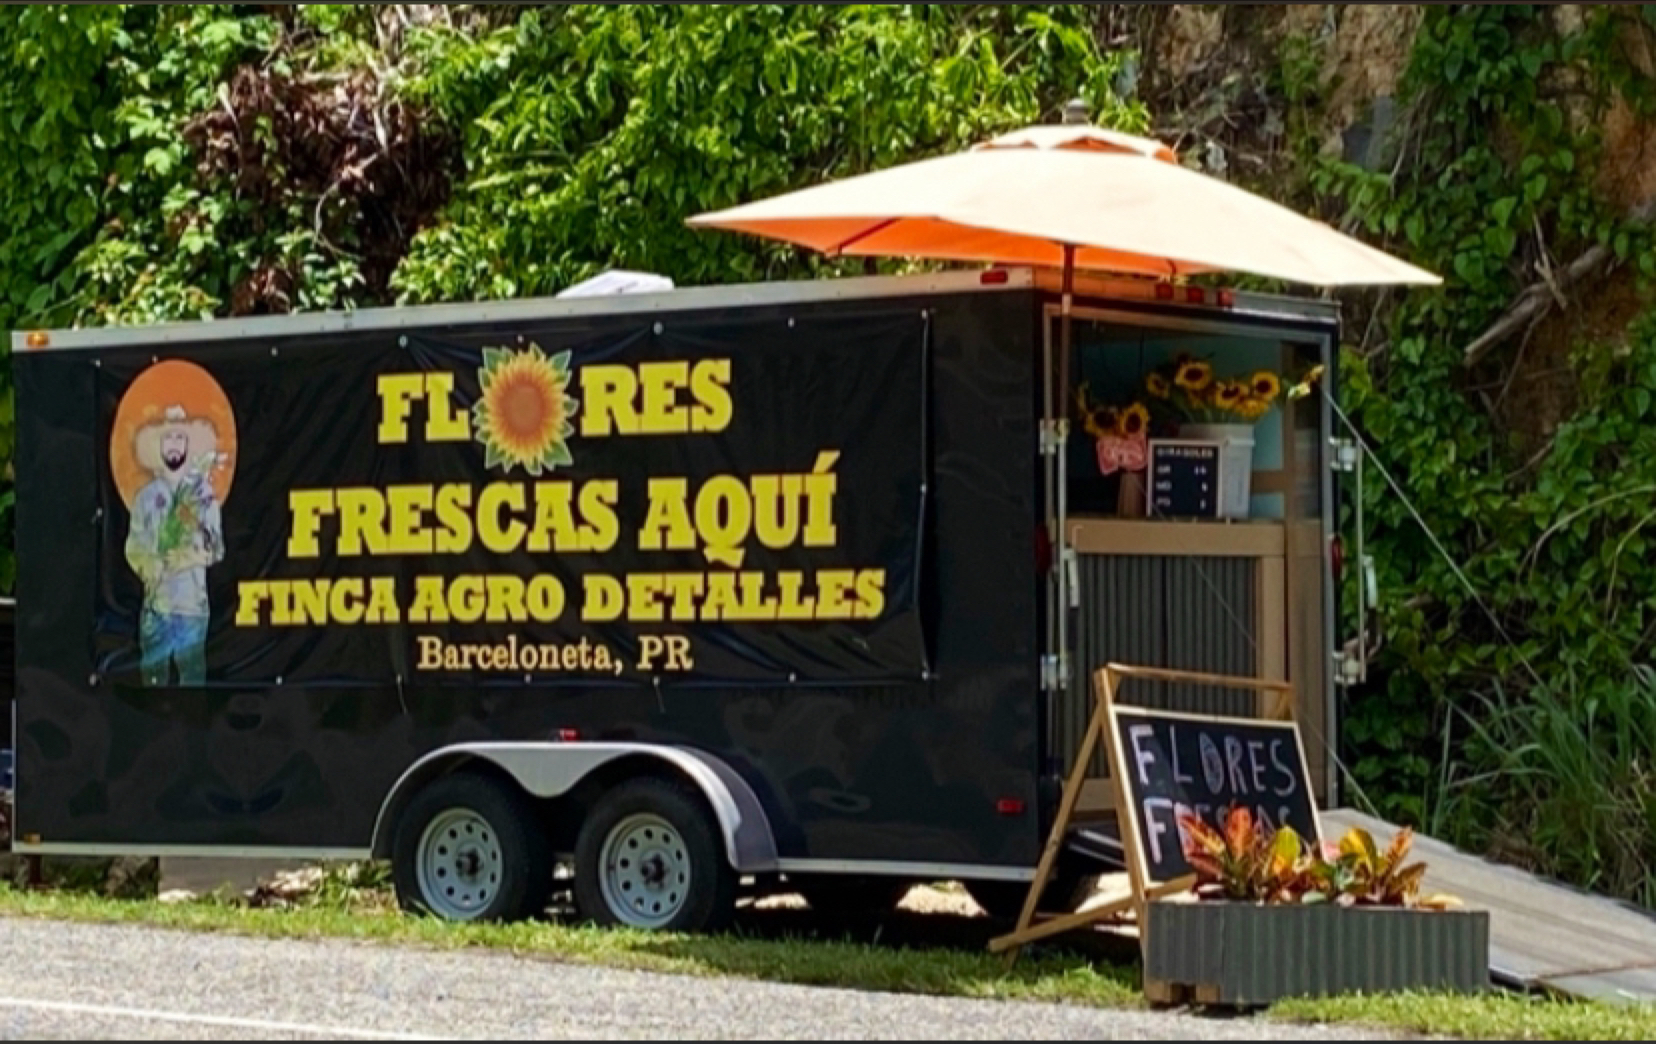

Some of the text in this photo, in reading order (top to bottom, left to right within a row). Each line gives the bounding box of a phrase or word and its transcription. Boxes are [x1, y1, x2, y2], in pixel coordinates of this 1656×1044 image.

[287, 451, 841, 568] FRESCAS AQUÍ
[235, 569, 885, 627] FINCA AGRO DETALLES
[417, 635, 694, 675] Barceloneta, PR
[1129, 724, 1297, 797] FLORES
